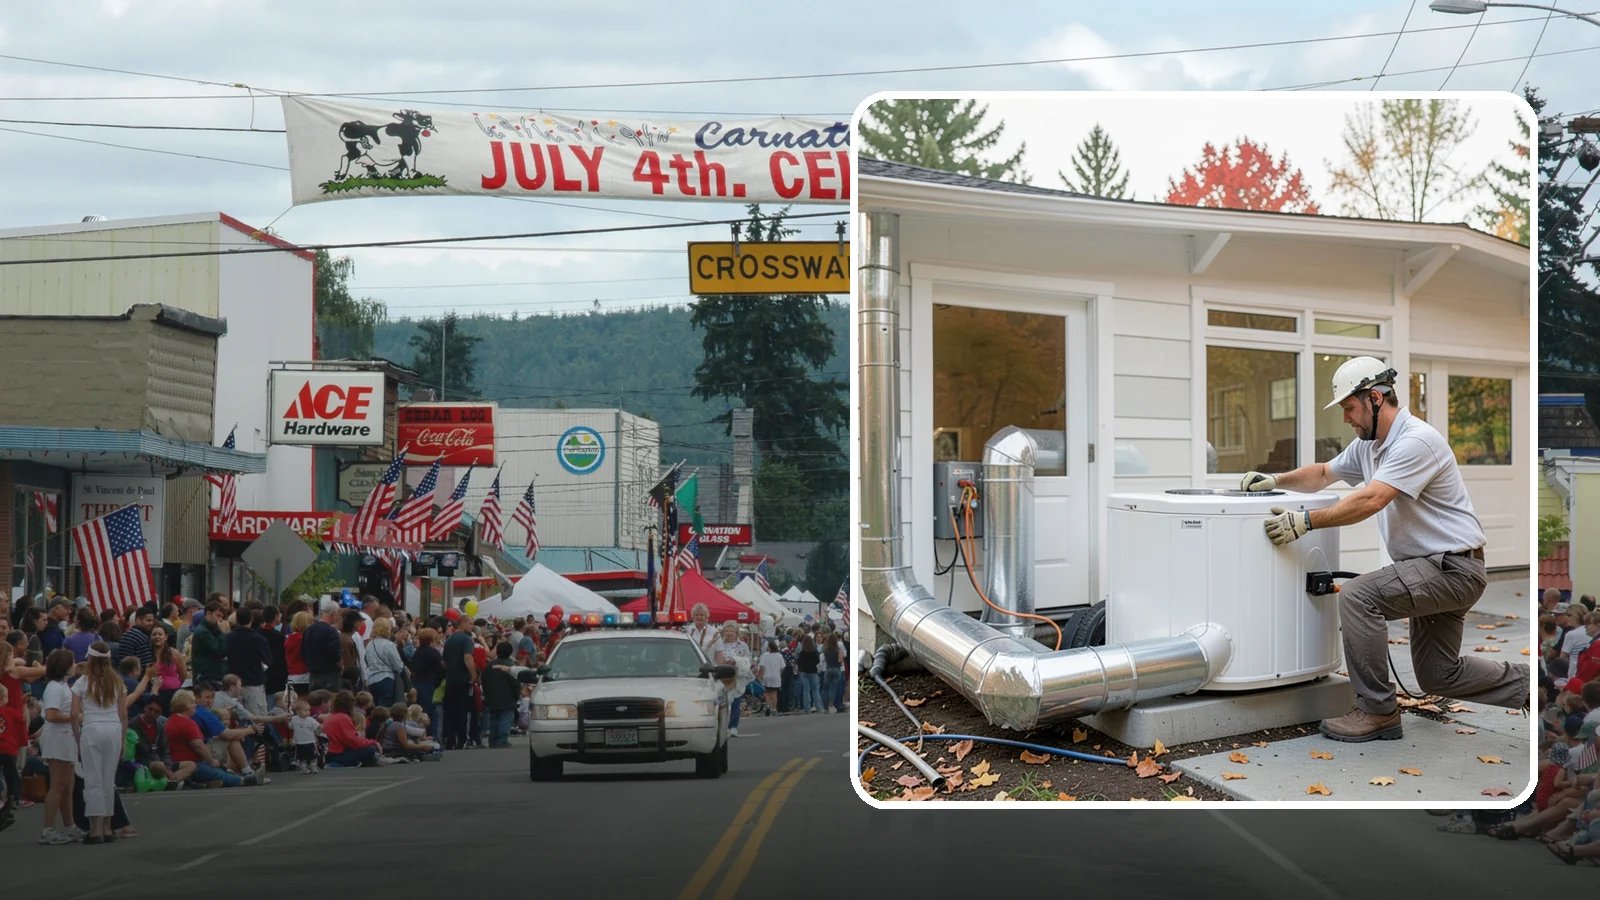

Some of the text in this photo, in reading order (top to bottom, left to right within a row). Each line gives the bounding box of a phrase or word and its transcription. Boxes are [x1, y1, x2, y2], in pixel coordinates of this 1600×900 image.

[481, 141, 605, 193] JULY
[632, 150, 746, 198] 4th.
[697, 254, 850, 280] CROSSWA
[283, 380, 373, 420] ACE
[406, 409, 485, 422] CEDAR LOG
[283, 421, 371, 436] Hardware
[353, 467, 386, 479] Simpl
[96, 485, 124, 495] Vincent
[126, 486, 136, 495] de
[137, 486, 155, 495] Paul
[688, 526, 741, 535] CRNATION
[699, 535, 730, 543] GLASS
